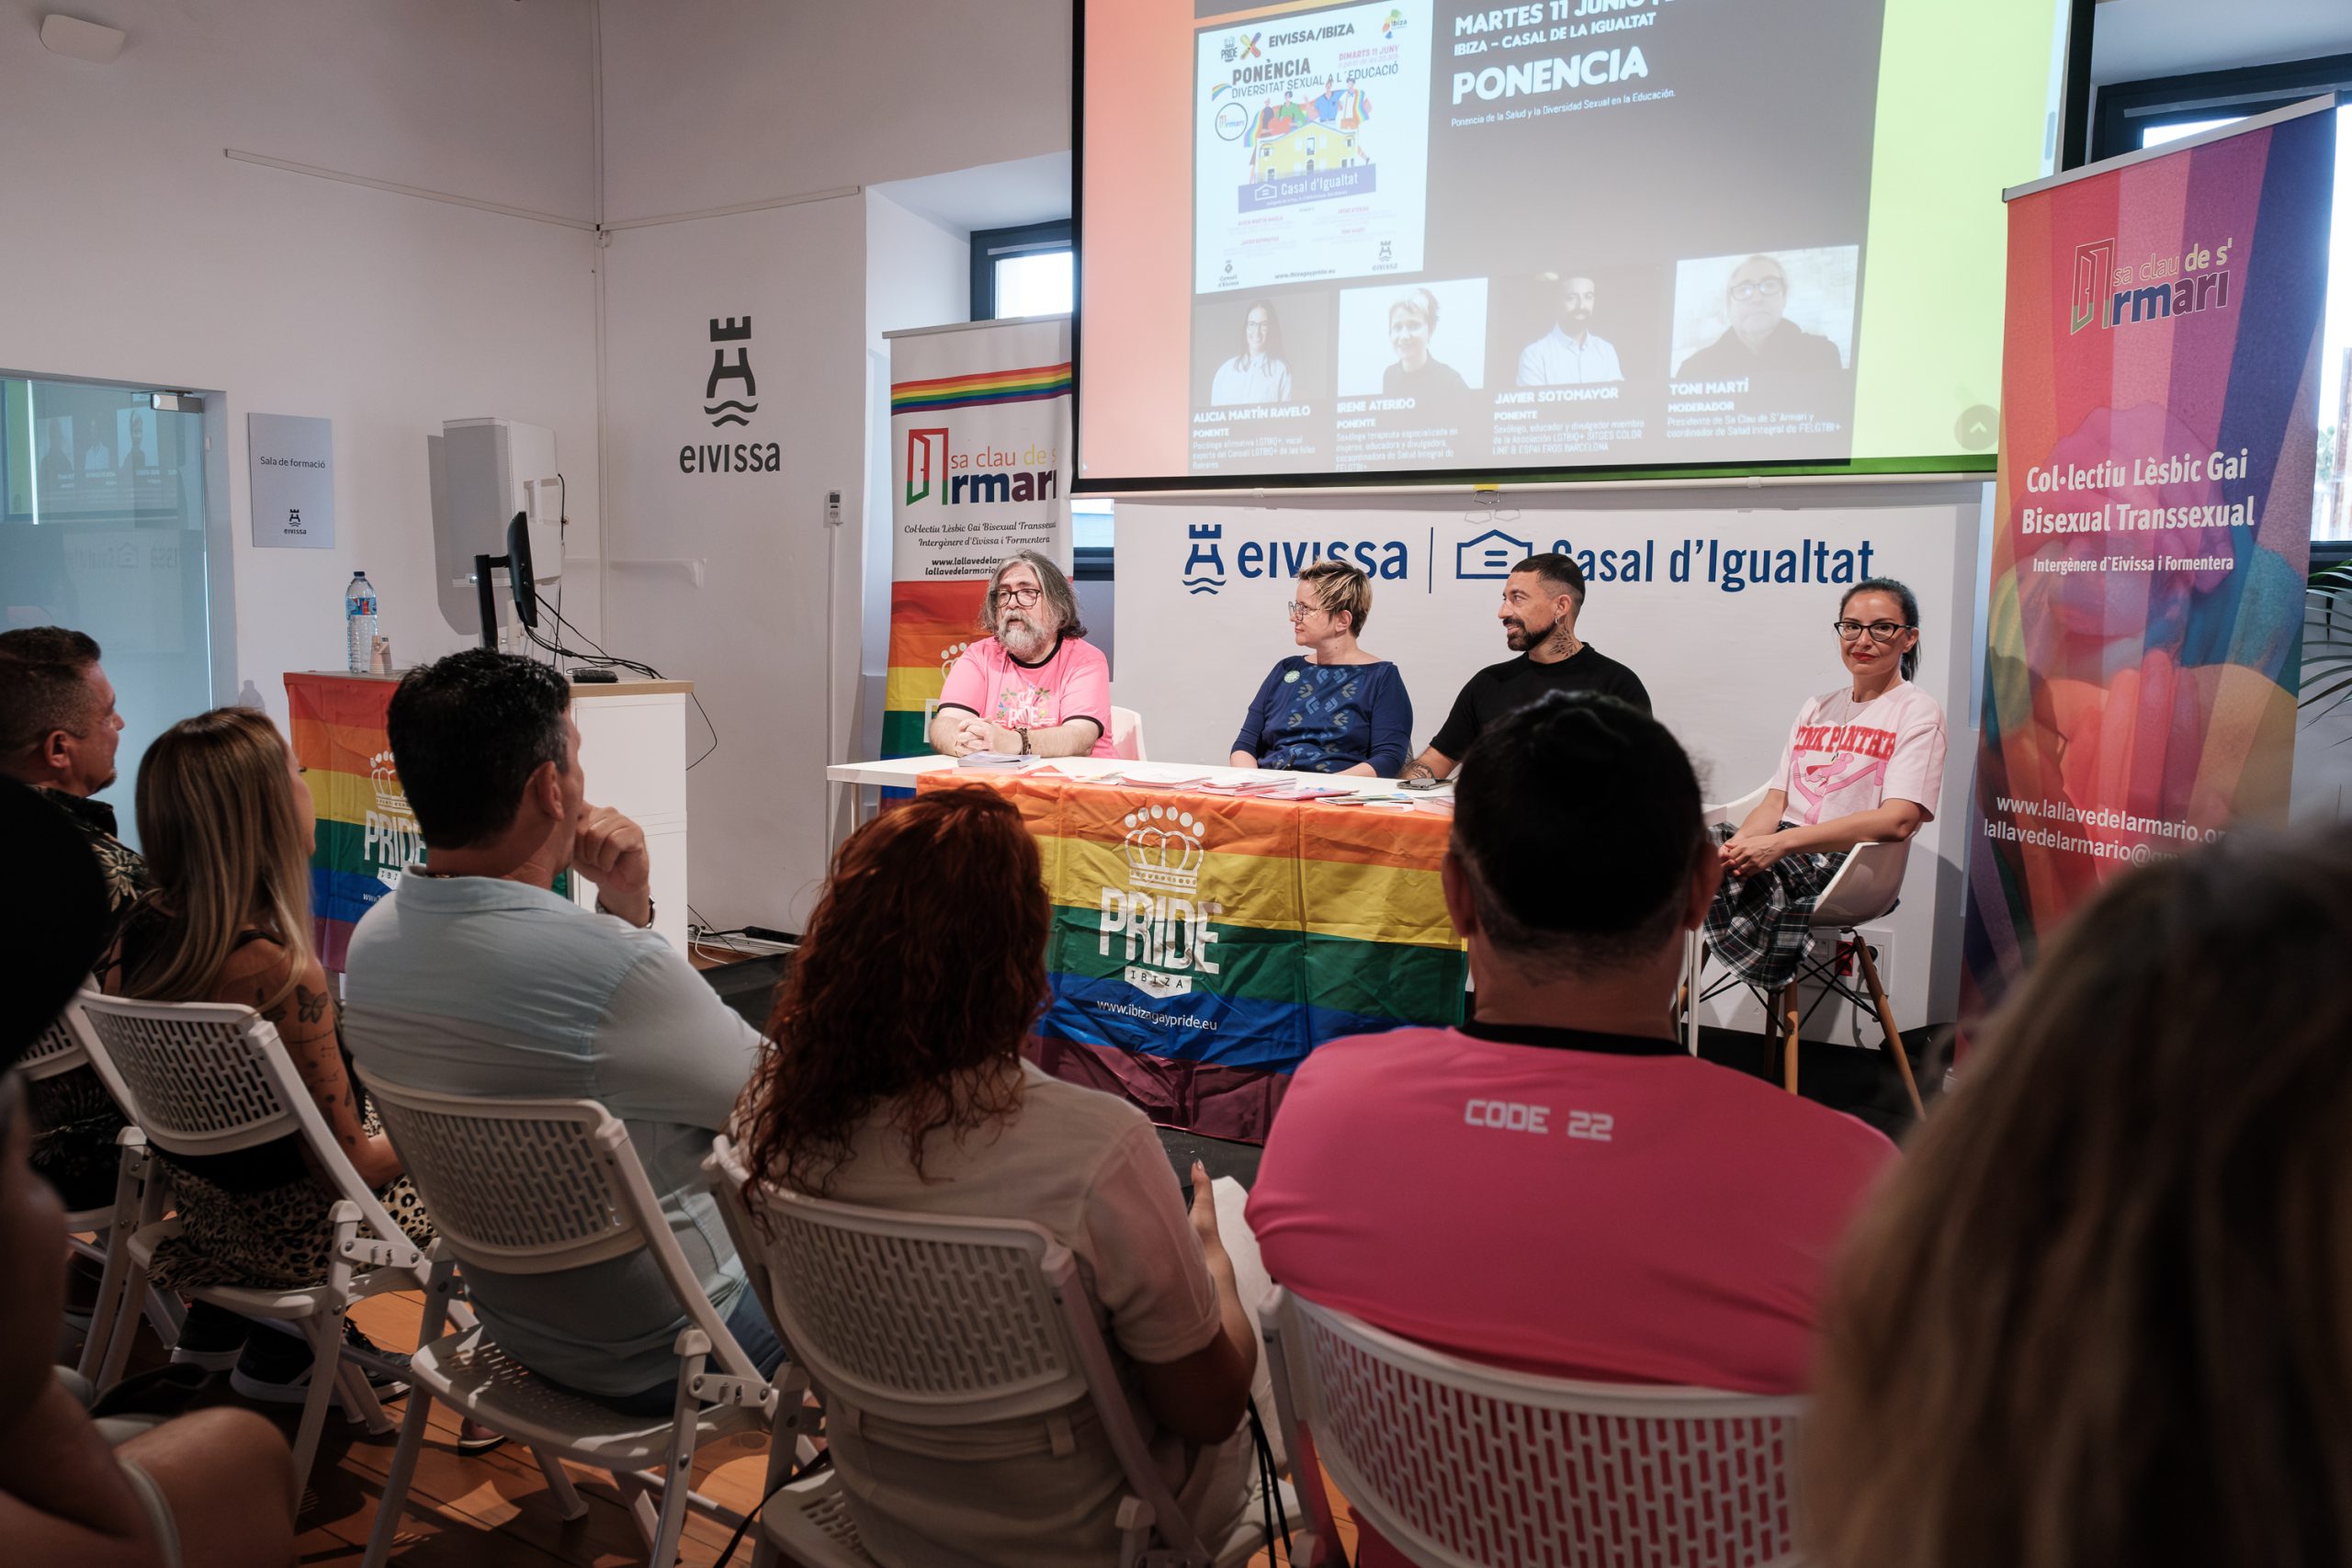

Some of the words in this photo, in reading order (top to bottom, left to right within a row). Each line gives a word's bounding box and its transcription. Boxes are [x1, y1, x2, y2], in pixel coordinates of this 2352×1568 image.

[1454, 3, 1544, 37] MARTES
[1550, 0, 1569, 20] 11
[1269, 23, 1355, 48] EIVISSA/IBIZA
[1454, 39, 1487, 57] IBIZA
[1501, 28, 1546, 50] CASAL
[1550, 26, 1567, 41] DE
[1570, 22, 1588, 38] LA
[1590, 12, 1657, 35] IGUALTAT
[1339, 49, 1371, 62] DIMARTS
[1379, 44, 1399, 55] JUNY
[1232, 57, 1311, 85] PONÈNCIA
[1452, 45, 1649, 106] PONENCIA
[1232, 81, 1284, 99] DIVERSITAT
[1287, 74, 1324, 91] SEXUAL
[1451, 116, 1485, 128] Ponencia
[1486, 114, 1496, 124] de
[1497, 112, 1504, 121] la
[1505, 108, 1526, 120] Salud
[1528, 109, 1533, 118] y
[1534, 106, 1542, 116] la
[1543, 100, 1582, 116] Diversidad
[1583, 96, 1609, 110] Sexual
[1611, 96, 1622, 106] en
[1623, 94, 1631, 104] la
[1632, 87, 1677, 103] Educación.
[1282, 181, 1307, 196] Casal
[1311, 172, 1359, 191] d'Igualtat
[2113, 266, 2132, 287] sa
[2140, 254, 2179, 281] clau
[2185, 243, 2211, 272] de
[2216, 237, 2233, 265] s'
[1495, 392, 1535, 404] JAVIER
[1537, 387, 1619, 402] SOTOMAYOR
[1669, 382, 1703, 396] TONI
[1705, 378, 1749, 395] MARTÍ
[1193, 412, 1227, 423] ALICIA
[1228, 406, 1268, 421] MARTÍN
[1270, 405, 1311, 418] RAVELO
[1337, 401, 1366, 413] IRENE
[1369, 398, 1416, 412] ATERIDO
[1668, 400, 1735, 413] MODERADOR
[1337, 418, 1376, 429] PONENTE
[1494, 411, 1538, 421] PONENTE
[1713, 416, 1723, 425] de
[1724, 414, 1736, 424] Sa
[1758, 413, 1768, 423] de
[1193, 428, 1229, 438] PONENTE
[1587, 430, 1614, 440] SITGES
[1715, 426, 1725, 435] de
[1726, 424, 1750, 434] Salud
[260, 456, 277, 466] Sala
[278, 457, 288, 467] de
[290, 458, 325, 468] formació
[680, 441, 780, 473] eivissa
[952, 454, 968, 468] sa
[977, 446, 1015, 468] clau
[1023, 442, 1046, 466] de
[2133, 453, 2202, 487] Lèsbic
[2207, 447, 2248, 481] Gai
[2022, 503, 2111, 535] Bisexual
[2116, 495, 2255, 531] Transsexual
[942, 523, 965, 533] Lèsbic
[967, 523, 980, 532] Gai
[982, 521, 1017, 531] Bisexual
[919, 537, 963, 549] Intergènere
[1005, 536, 1050, 545] Formentera
[932, 556, 1001, 566] www.lallavedelar
[1670, 539, 1874, 592] d'Igualtat
[2032, 557, 2097, 575] Intergènere
[2157, 555, 2162, 571] i
[2165, 554, 2234, 571] Formentera
[925, 567, 996, 576] lallavedelarmario
[381, 870, 399, 881] IBI
[1099, 886, 1223, 975] PRIDE
[1131, 970, 1183, 988] IBIZA
[1097, 999, 1217, 1031] www.ibizagaypride.eu
[1464, 1098, 1551, 1134] CODE
[1567, 1110, 1614, 1142] 22
